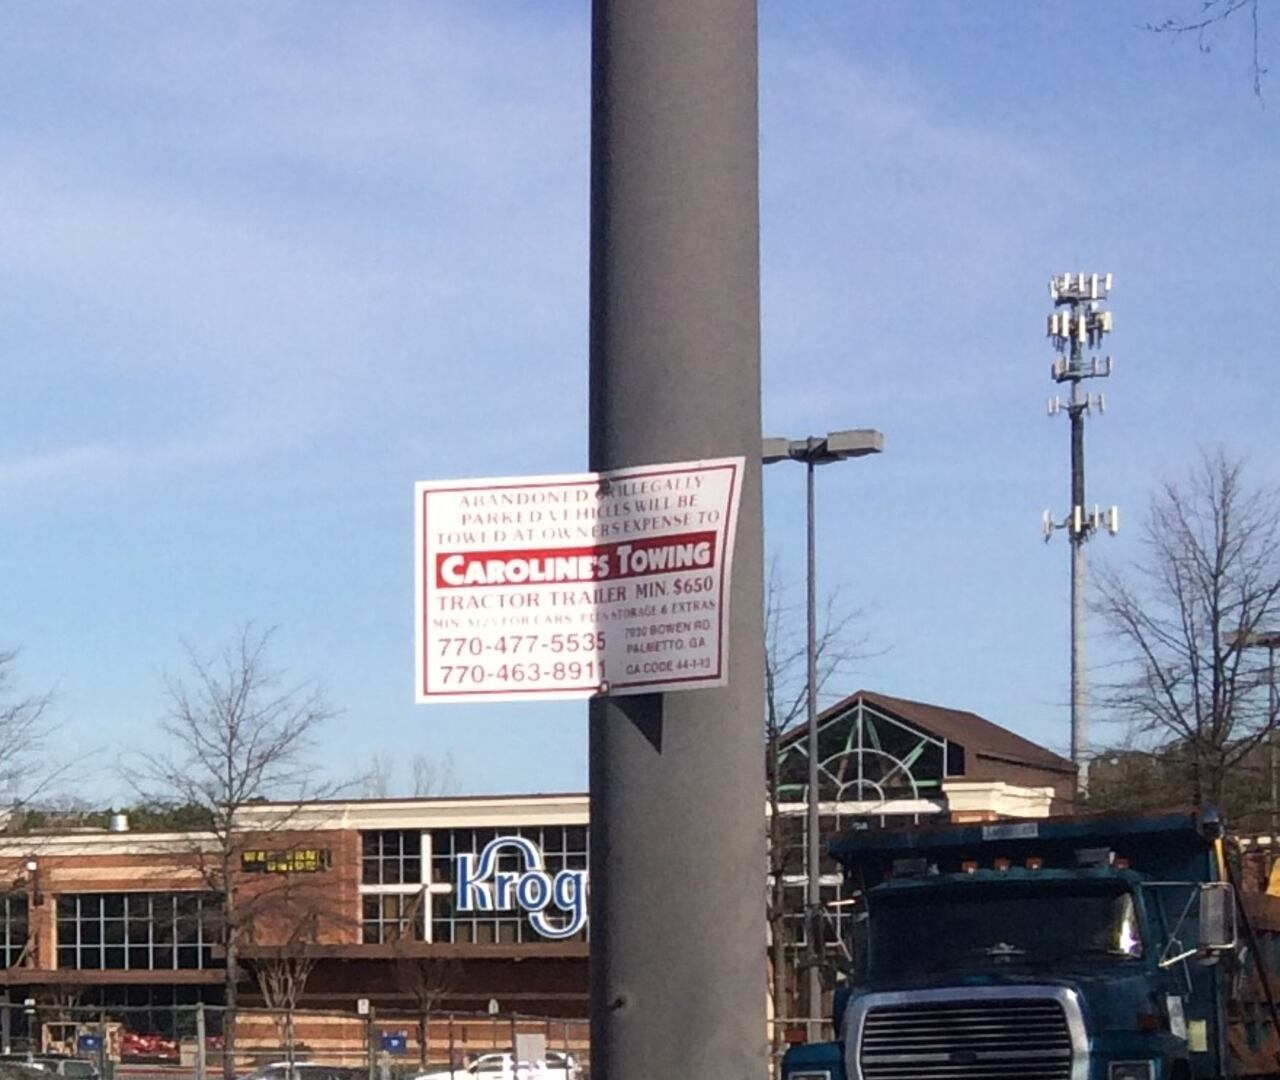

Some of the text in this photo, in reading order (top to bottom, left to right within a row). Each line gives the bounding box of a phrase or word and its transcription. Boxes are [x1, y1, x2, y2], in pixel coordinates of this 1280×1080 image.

[459, 489, 589, 508] ABANDONED
[617, 475, 705, 497] ILLEGALLY
[461, 493, 698, 526] PARKED VEHICLES WILL BE
[437, 530, 507, 545] TOWED
[513, 528, 535, 542] AT
[623, 511, 690, 533] EXPENSE
[698, 510, 720, 524] TO
[616, 542, 712, 575] TOWING
[437, 591, 540, 611] TRACTOR
[549, 586, 626, 607] TRAILER
[673, 575, 714, 596] $650
[611, 606, 658, 620] STORAGE
[660, 604, 668, 615] &
[672, 599, 716, 614] EXTRAS
[438, 630, 607, 657] 770-477-5535
[649, 621, 691, 636] BOWEN
[689, 637, 706, 648] GA
[439, 659, 607, 685] 770-463-8911
[626, 664, 641, 675] GA
[643, 661, 674, 674] CODE
[456, 835, 589, 939] Krog
